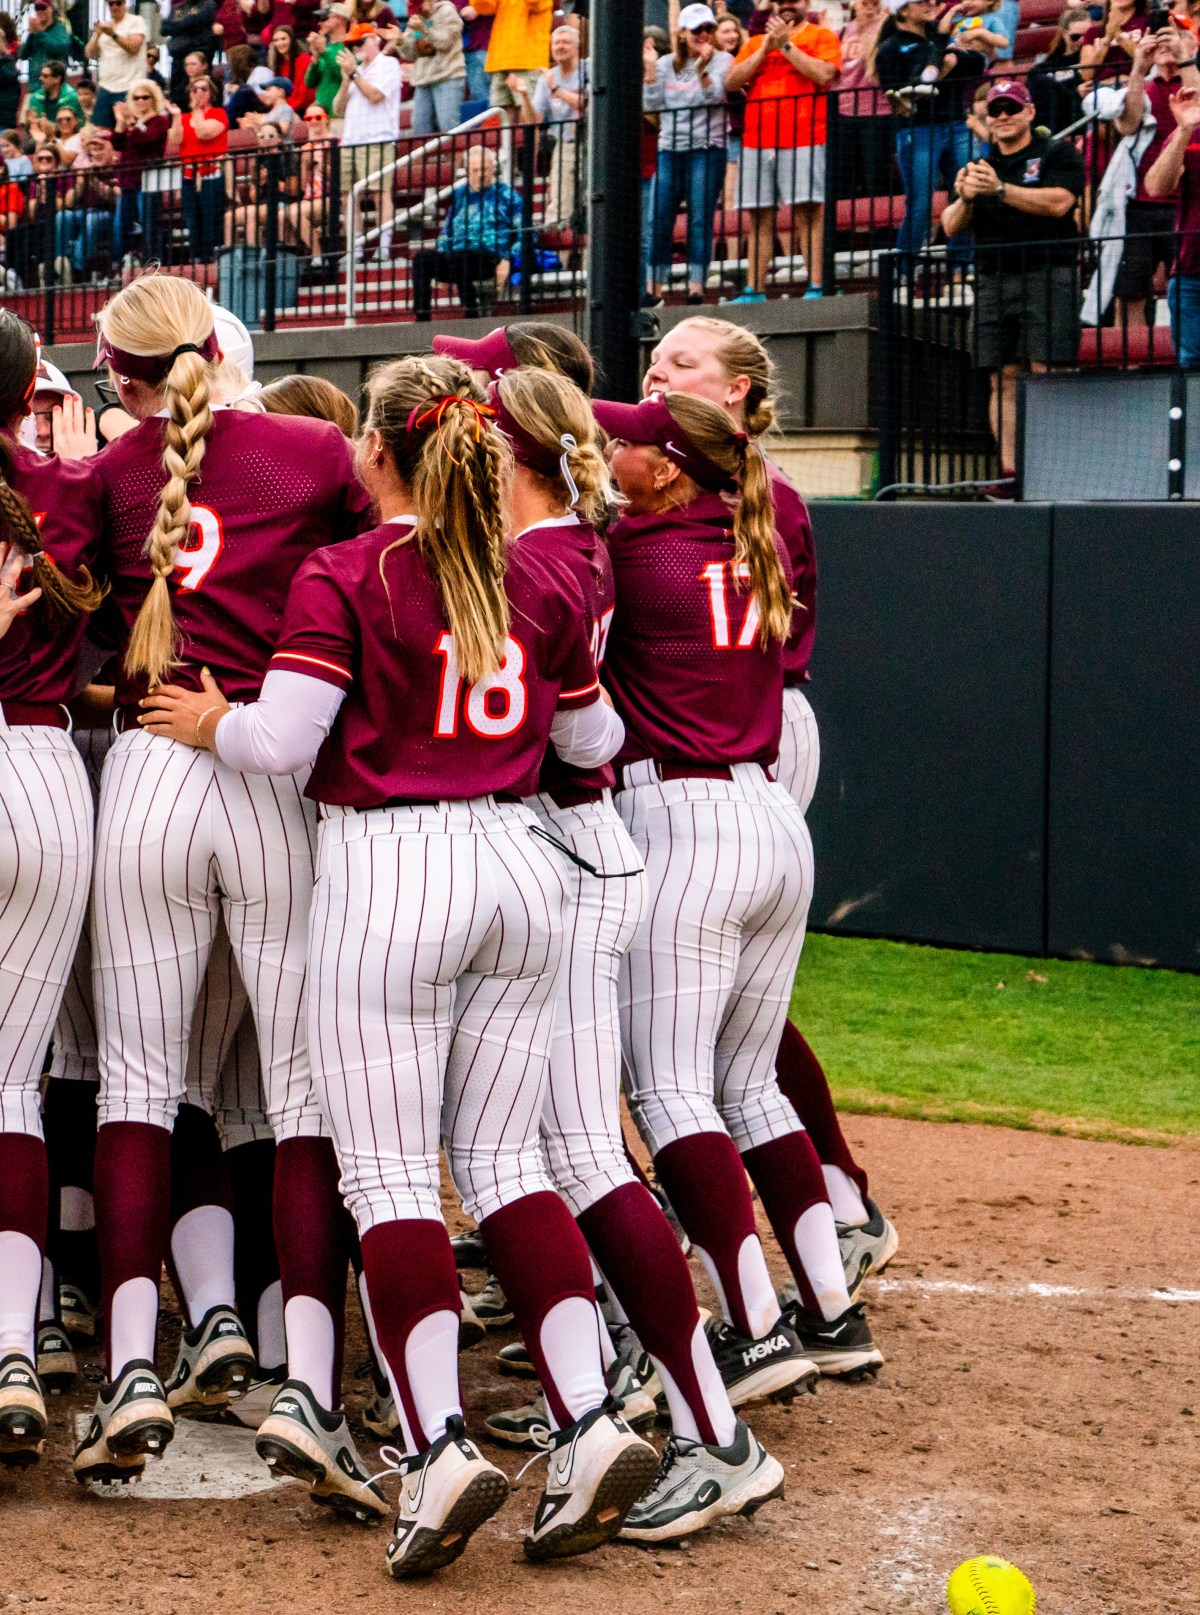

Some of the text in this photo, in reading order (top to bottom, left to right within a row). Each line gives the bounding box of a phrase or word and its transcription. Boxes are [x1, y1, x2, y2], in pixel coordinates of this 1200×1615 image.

[174, 503, 224, 595] 9
[432, 630, 528, 739] 18
[218, 1322, 238, 1332] NIKE
[43, 1339, 62, 1350] NIKE
[742, 1334, 791, 1367] HOKA
[7, 1373, 31, 1384] NIKE
[133, 1382, 158, 1393] NIKE
[272, 1401, 299, 1414] NIKE
